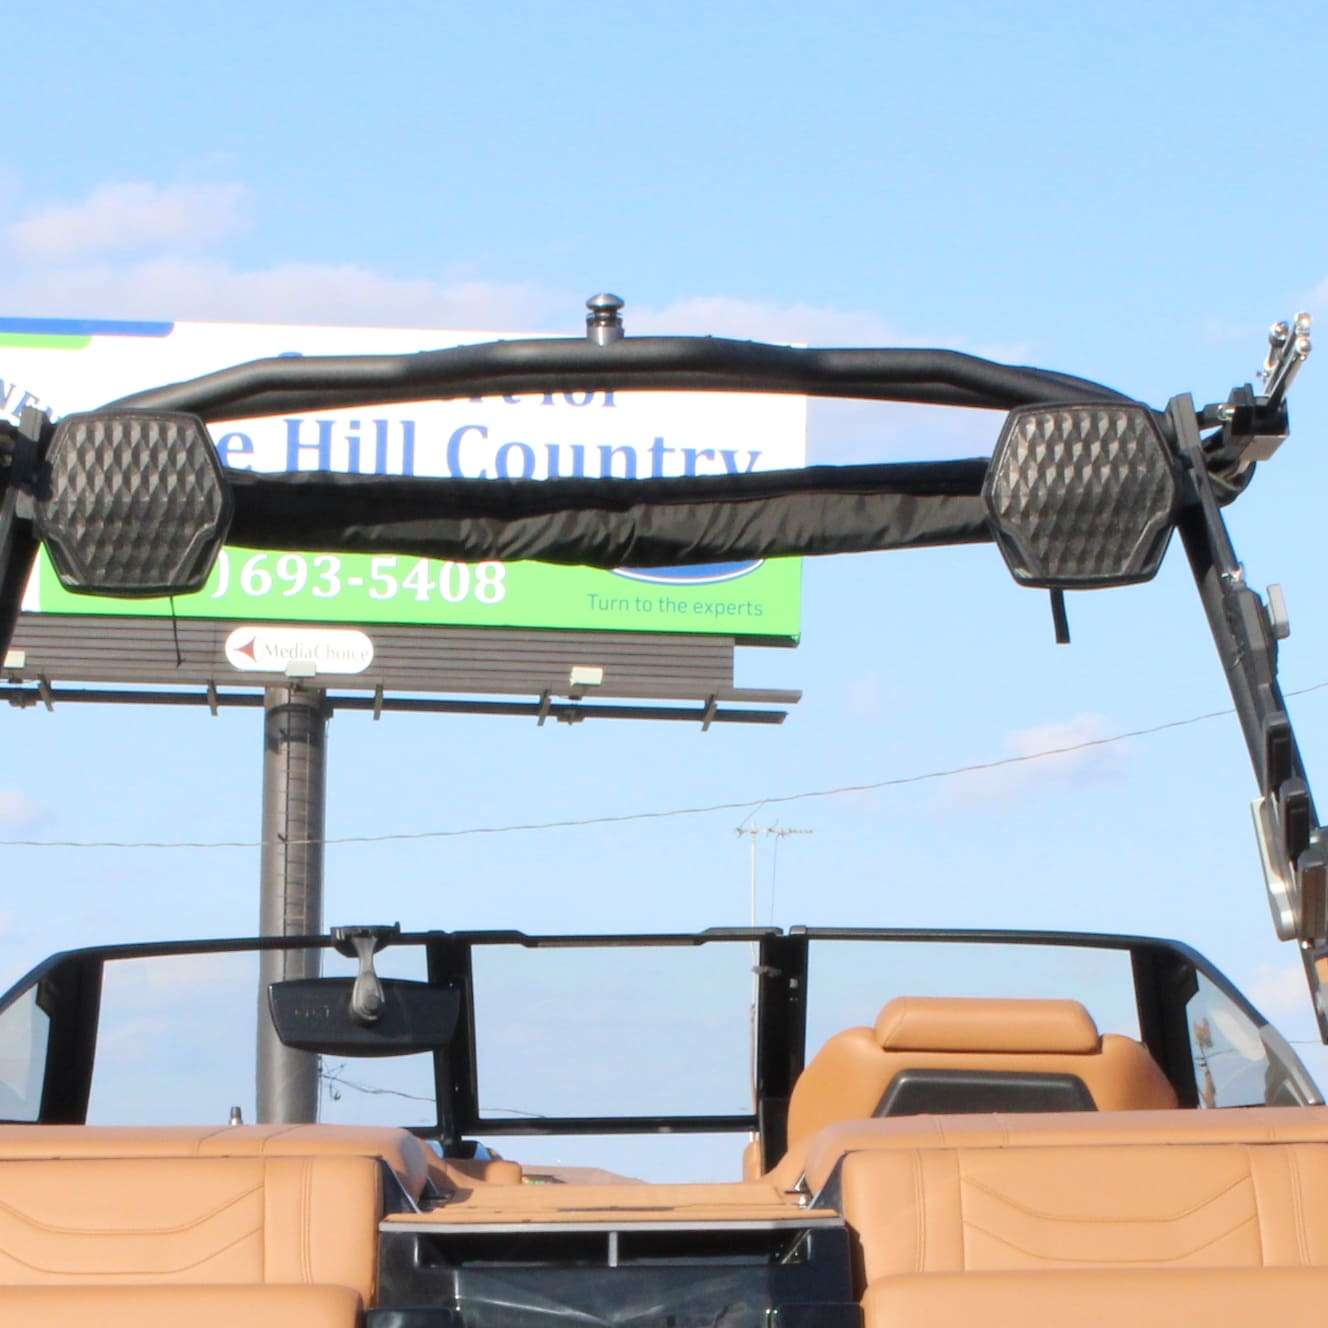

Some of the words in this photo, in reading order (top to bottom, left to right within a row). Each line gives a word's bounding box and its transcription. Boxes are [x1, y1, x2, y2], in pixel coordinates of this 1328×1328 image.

[283, 418, 416, 477] Hill
[212, 551, 506, 604] )693-5408
[587, 593, 629, 611] Turn
[635, 597, 653, 612] to
[659, 596, 688, 614] the
[693, 600, 764, 619] experts
